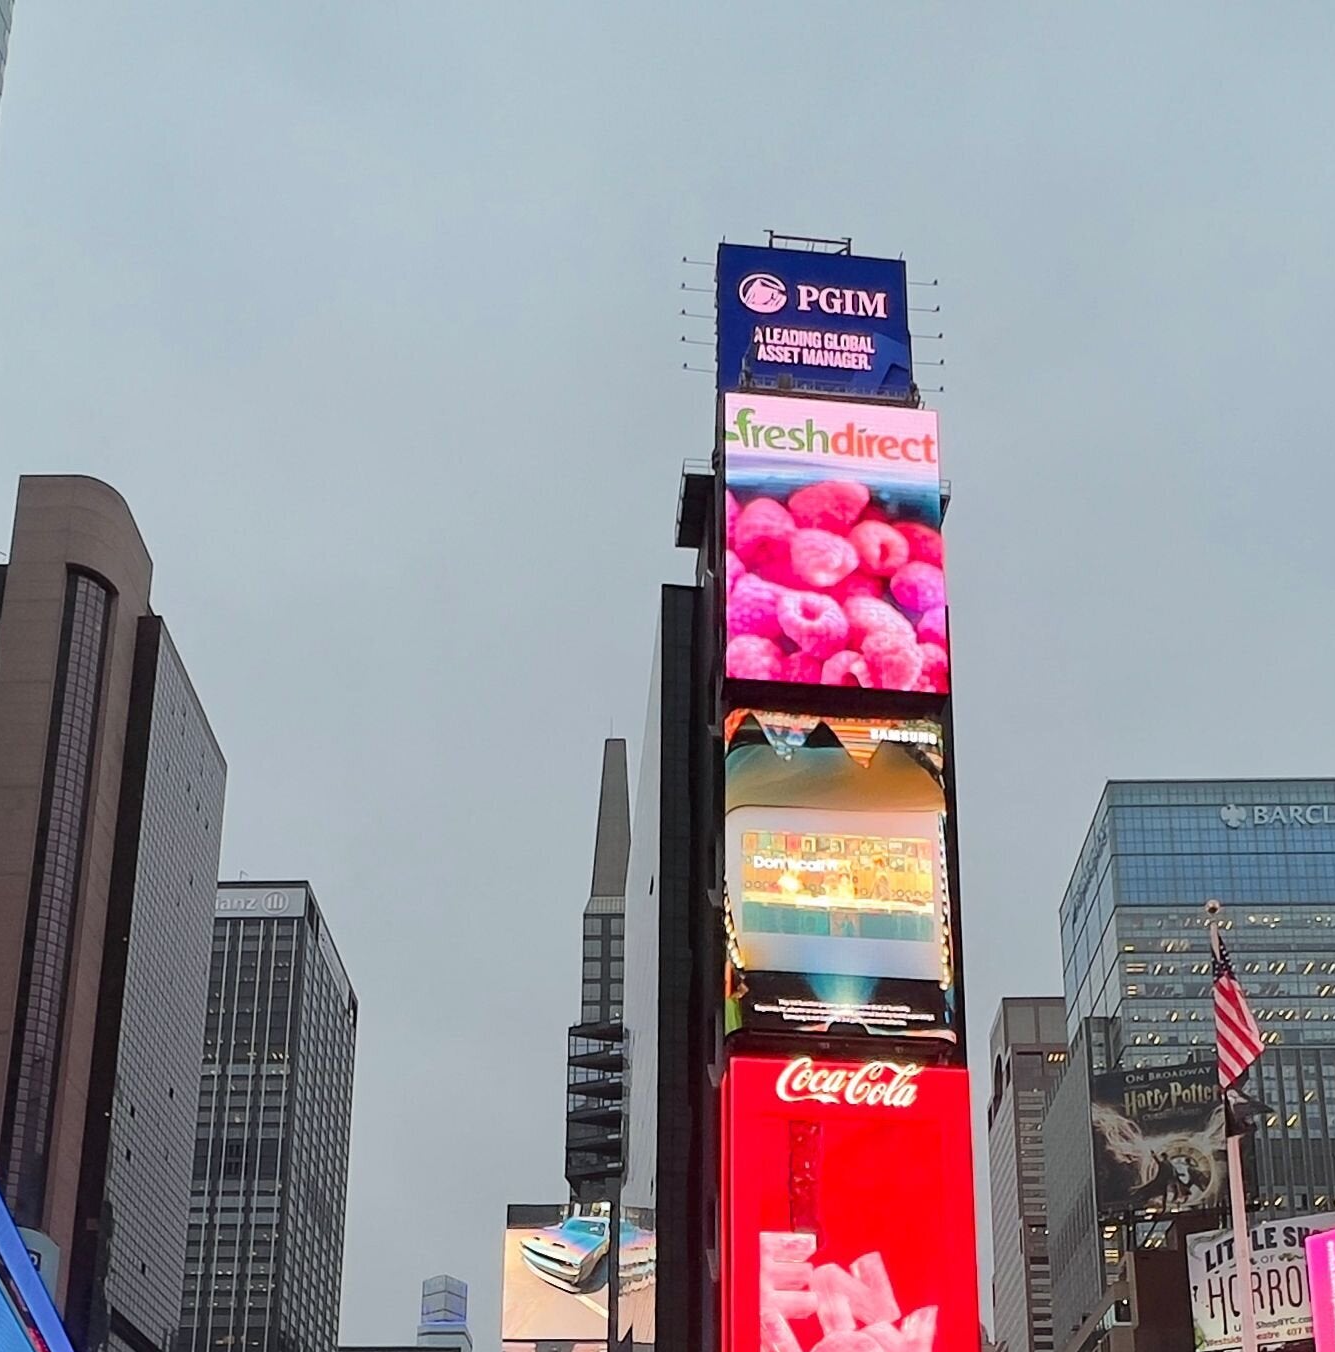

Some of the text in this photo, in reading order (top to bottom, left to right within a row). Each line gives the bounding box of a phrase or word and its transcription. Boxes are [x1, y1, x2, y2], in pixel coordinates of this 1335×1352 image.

[797, 284, 889, 319] PGIM
[754, 326, 876, 354] A LEADING GLOBAL
[757, 344, 872, 371] ASSET MANAGER.
[732, 407, 937, 464] freshdirect
[870, 728, 938, 746] SAMSUNG
[775, 1056, 925, 1109] Coca-Cola
[1148, 1066, 1212, 1082] BROADWAY
[1124, 1088, 1168, 1119] Harry
[1169, 1081, 1218, 1109] Potter
[1205, 1226, 1278, 1273] LITLE
[1260, 1254, 1275, 1264] OF
[1207, 1265, 1312, 1336] HORRO
[1205, 1336, 1242, 1346] Westsid
